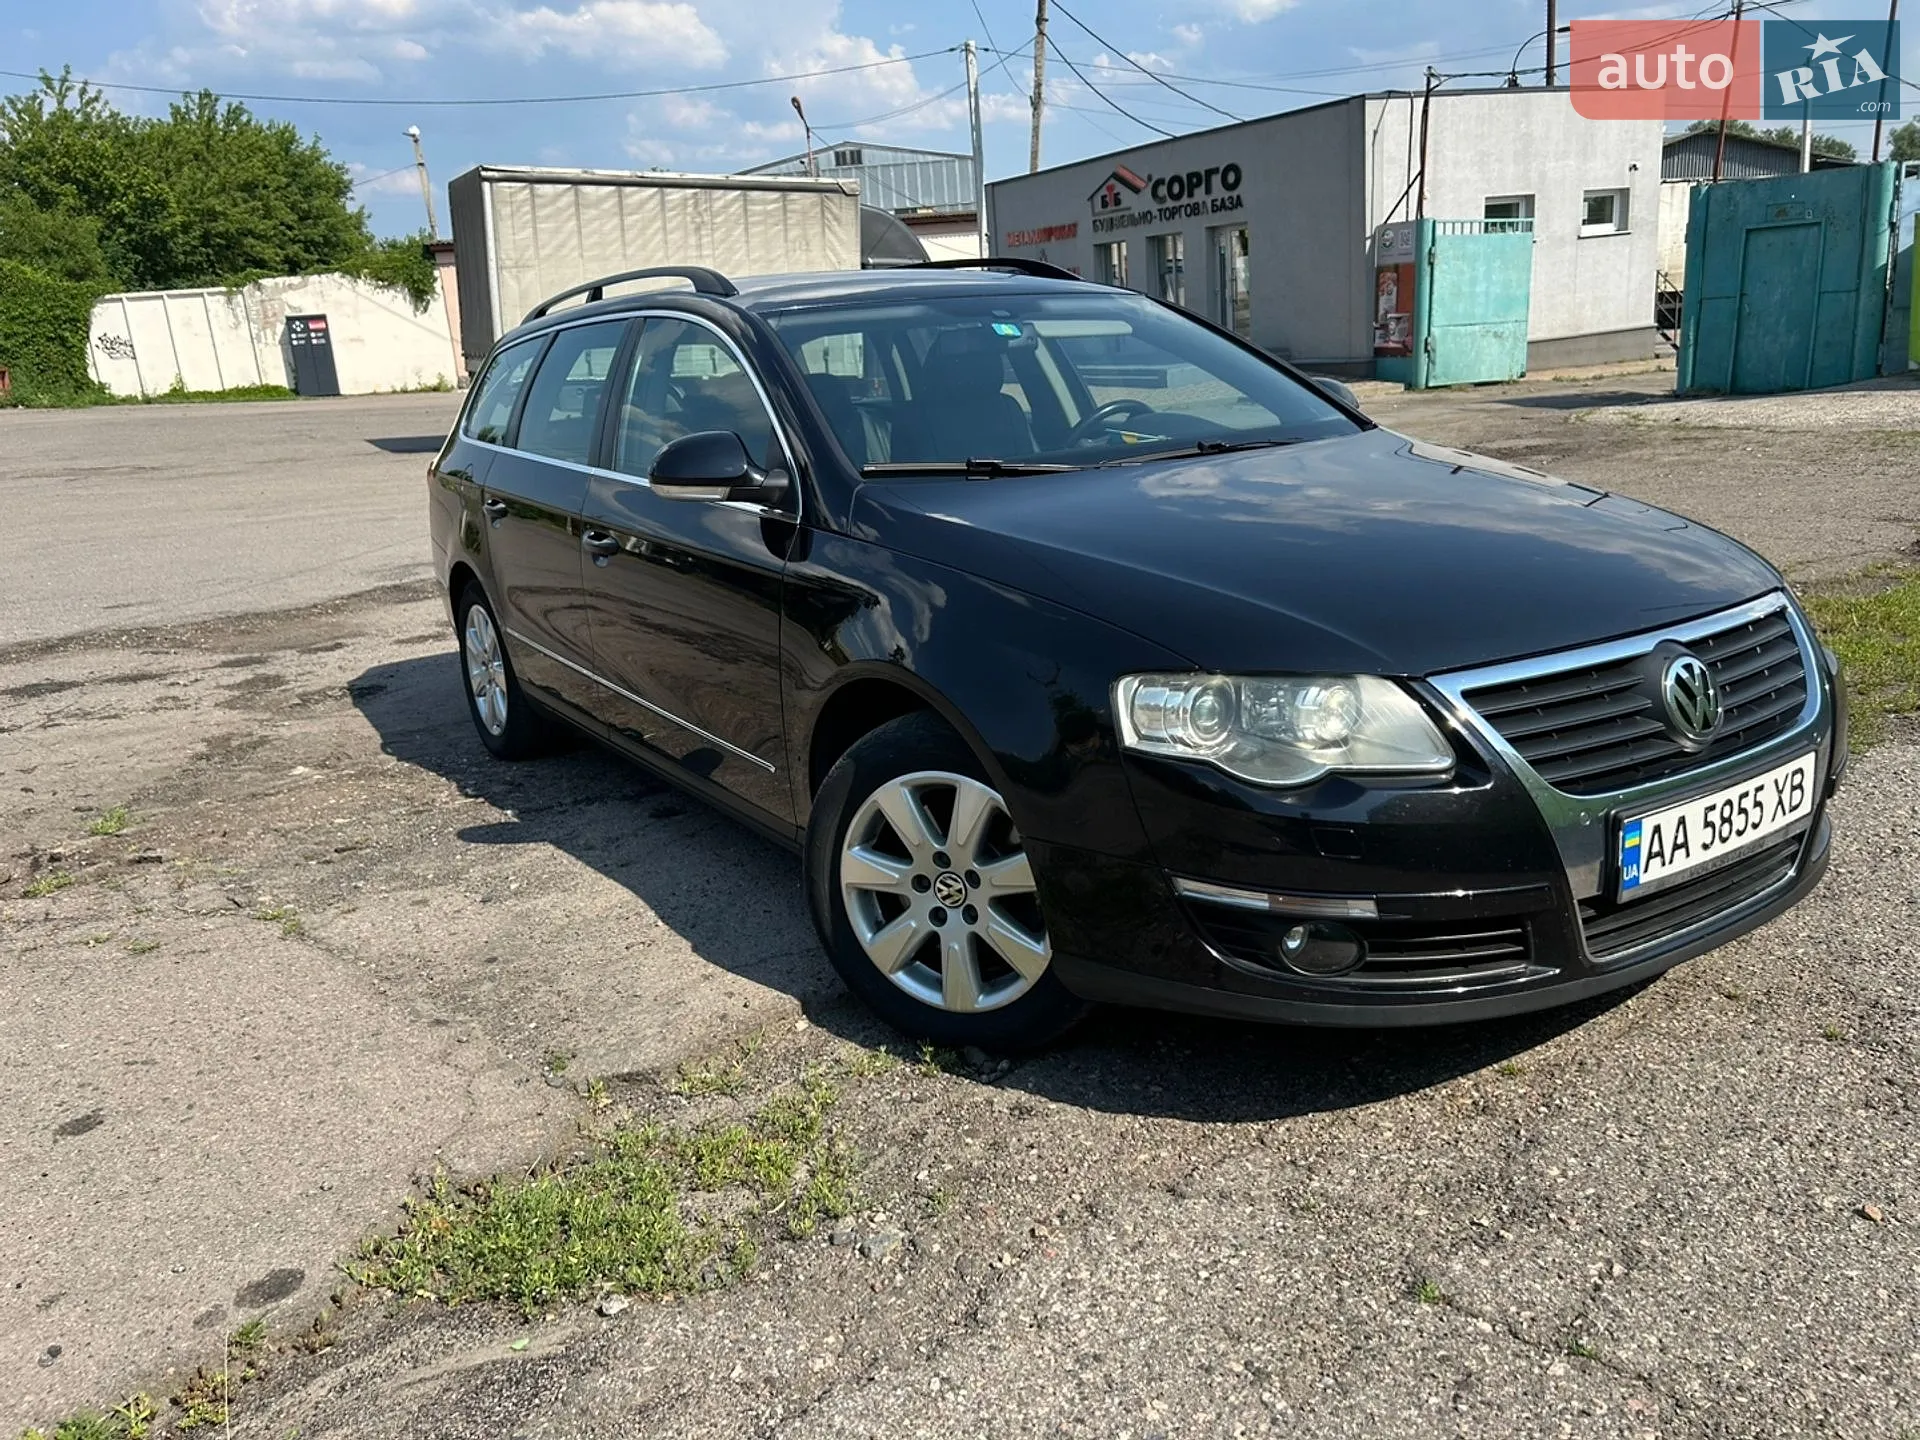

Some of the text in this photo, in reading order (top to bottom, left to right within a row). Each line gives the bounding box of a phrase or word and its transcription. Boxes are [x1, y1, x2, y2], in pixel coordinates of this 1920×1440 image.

[1151, 163, 1242, 204] СОРГО
[1211, 195, 1244, 214] БАЗА
[1643, 815, 1691, 874] AA
[1700, 783, 1765, 851] 5855
[1771, 767, 1805, 823] XB
[1623, 863, 1639, 880] UA
